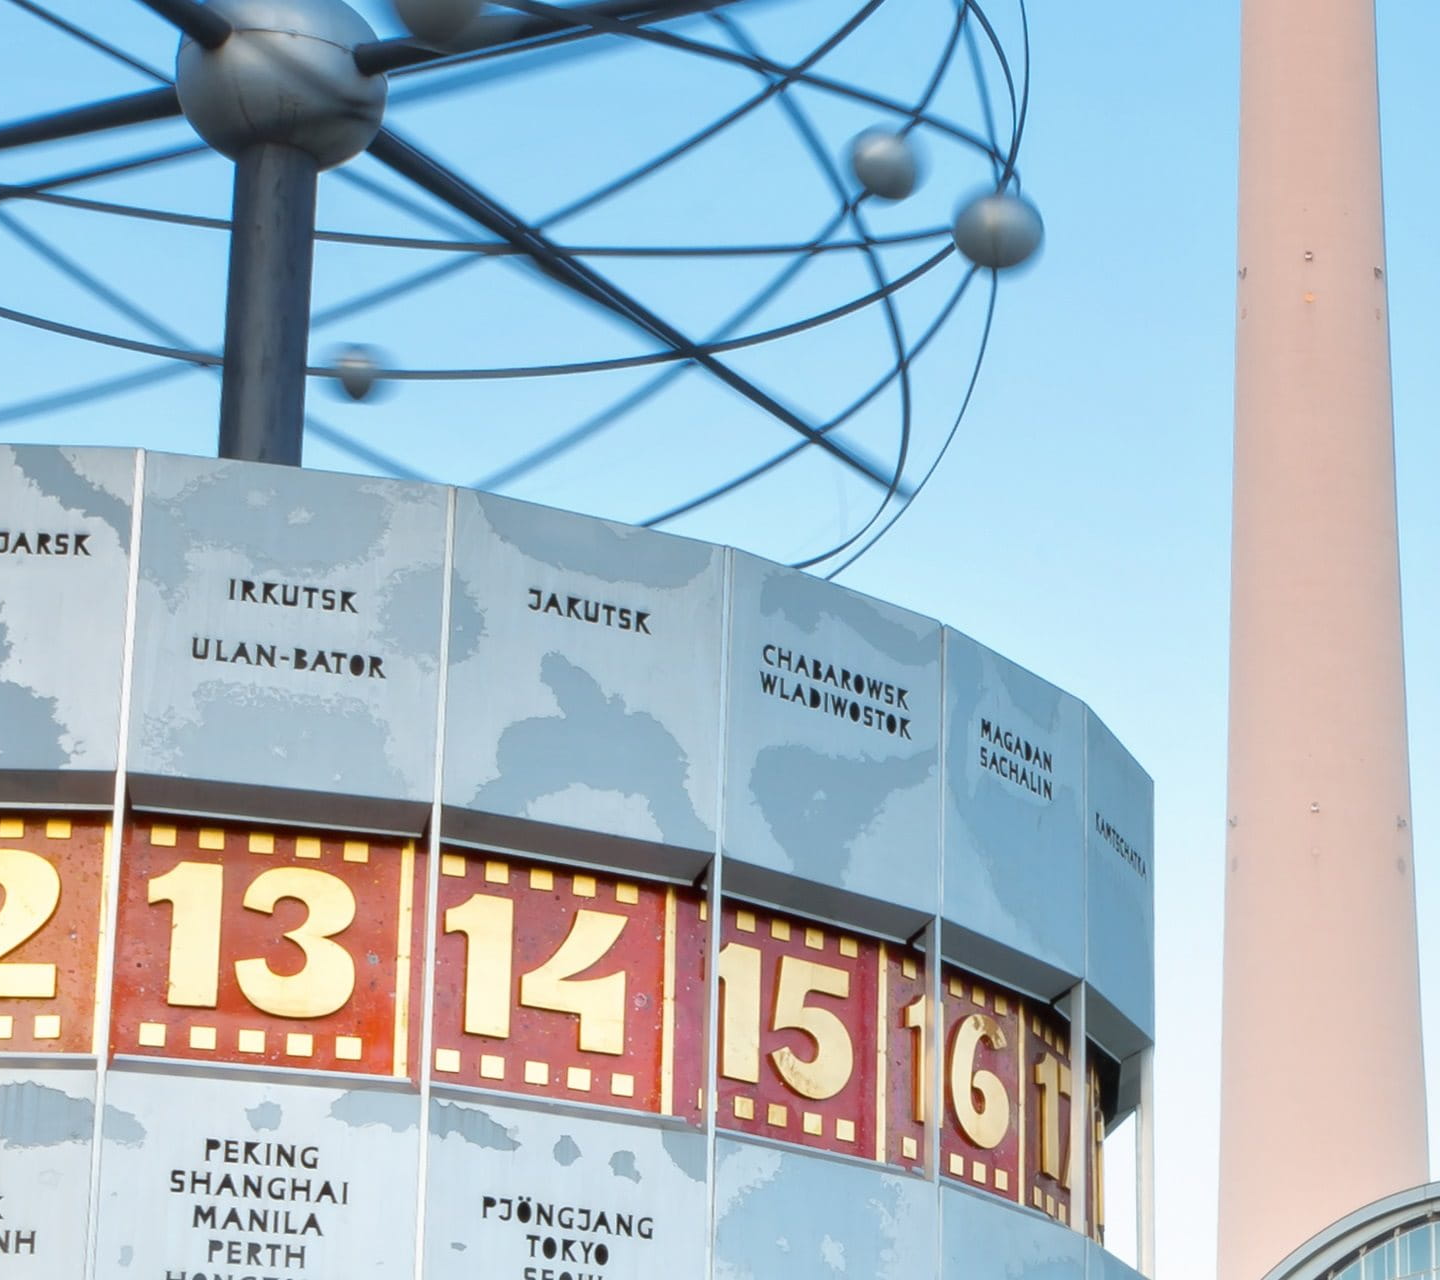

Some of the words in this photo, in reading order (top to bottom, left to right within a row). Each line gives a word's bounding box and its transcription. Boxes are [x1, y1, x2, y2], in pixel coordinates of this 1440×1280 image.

[229, 578, 359, 614] IRKUTSK
[528, 588, 652, 635] JAKUTSK
[192, 636, 387, 679] ULAN-BATOR
[762, 644, 909, 710] CHABAROWSK
[760, 671, 911, 740] WLADIWOSTOK
[980, 717, 1052, 774] MAGADAN
[980, 746, 1052, 801] SACHALIN
[1095, 811, 1146, 881] KAMTSCHATKA
[148, 861, 357, 1018] 13
[445, 893, 629, 1056] 14
[719, 942, 853, 1100] 15
[904, 992, 1010, 1150] 16
[204, 1138, 320, 1170] PEKING
[170, 1169, 349, 1205] SHANGHAI
[192, 1205, 323, 1237] MANILA
[482, 1195, 654, 1240] PJÖNGJANG
[207, 1239, 306, 1270] PERTH
[525, 1233, 610, 1267] TOKYO
